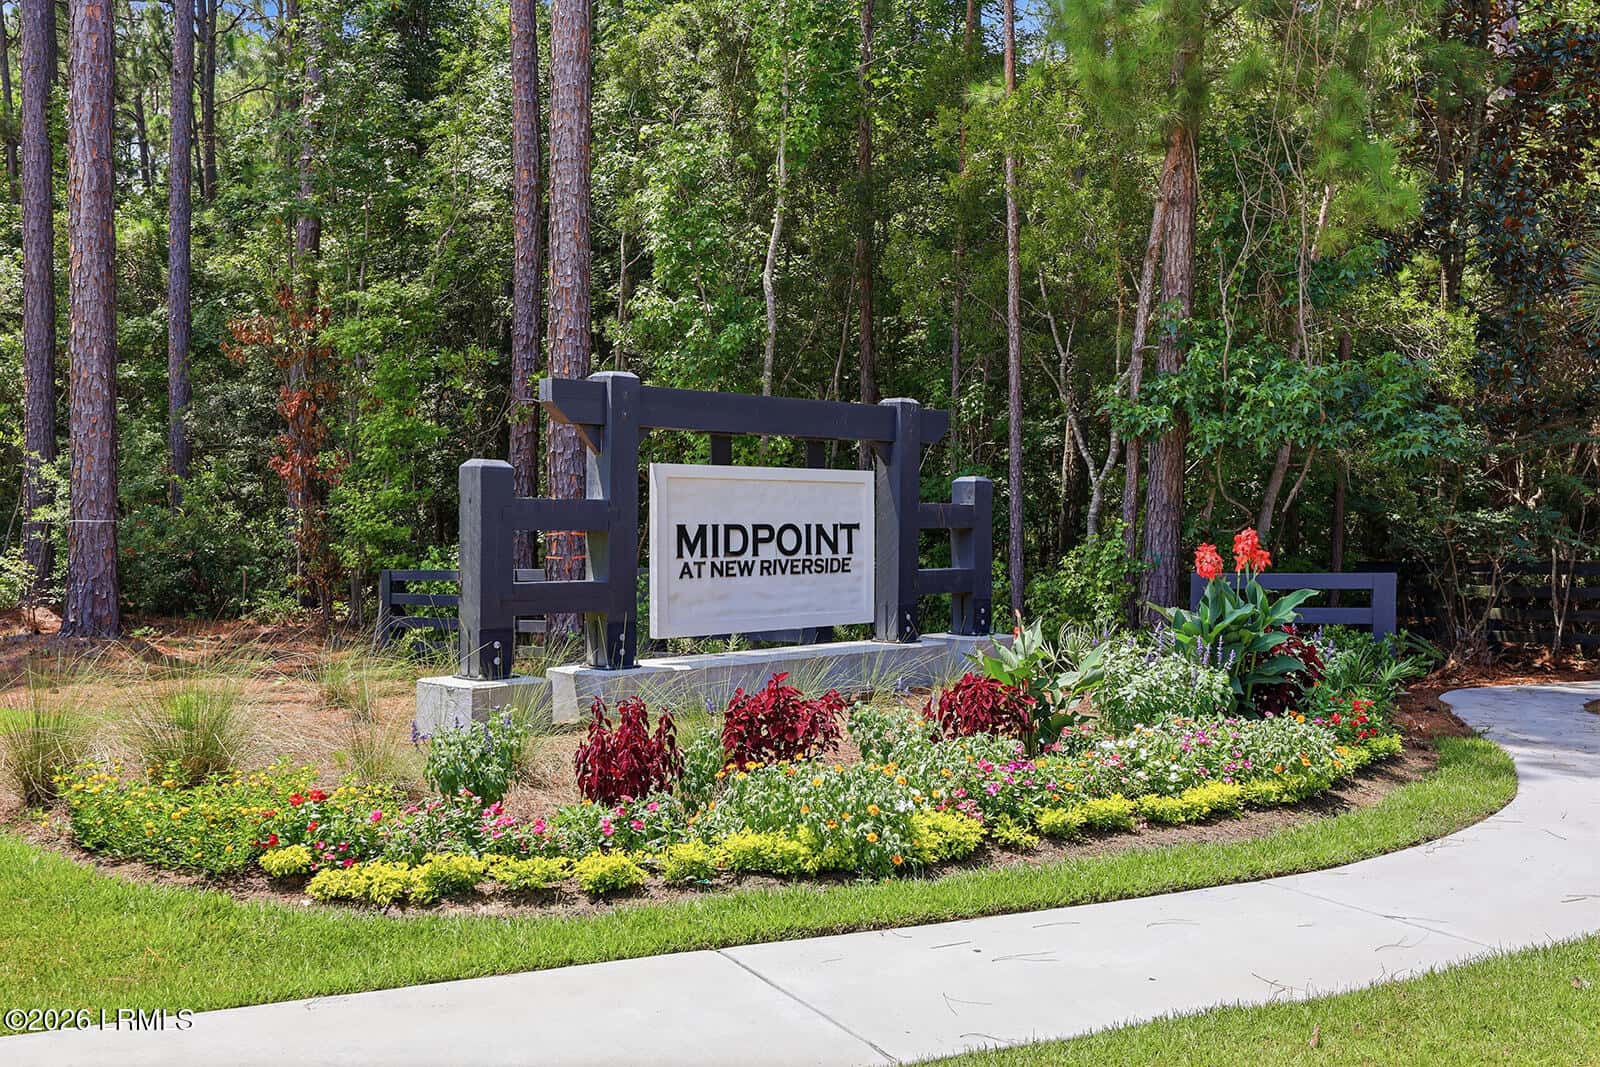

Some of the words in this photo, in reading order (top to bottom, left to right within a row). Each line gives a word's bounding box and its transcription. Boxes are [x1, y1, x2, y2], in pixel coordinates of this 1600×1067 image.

[676, 523, 860, 559] MIDPOINT
[679, 561, 706, 579] AT
[710, 560, 755, 578] NEW
[759, 557, 852, 576] RIVERSIDE
